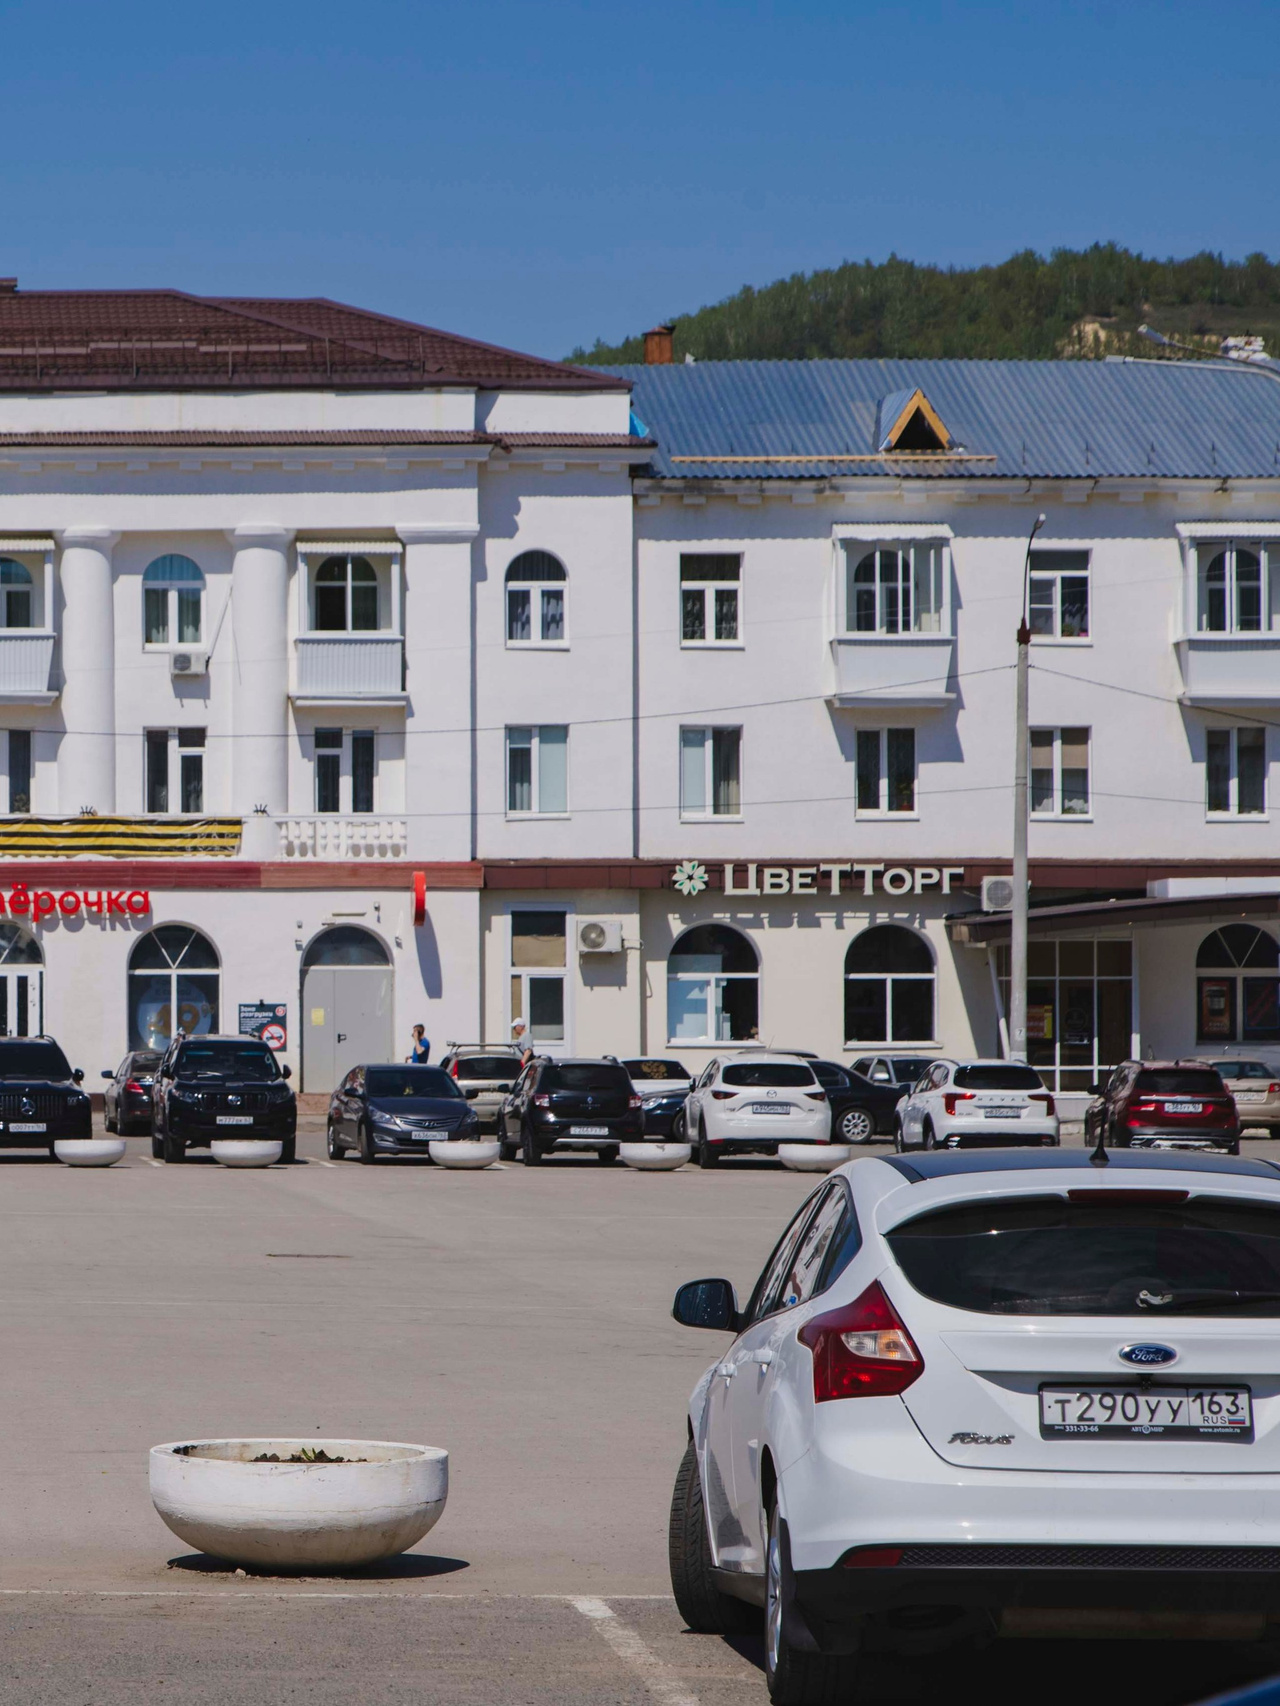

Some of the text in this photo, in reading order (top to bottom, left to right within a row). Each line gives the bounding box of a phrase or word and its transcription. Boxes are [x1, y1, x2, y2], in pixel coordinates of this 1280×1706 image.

[1131, 1348, 1165, 1362] Ford
[1054, 1392, 1239, 1423] Т290УУ 163
[1202, 1416, 1227, 1425] RUS
[1065, 1425, 1099, 1433] 331-33-66
[947, 1432, 1015, 1445] Focus
